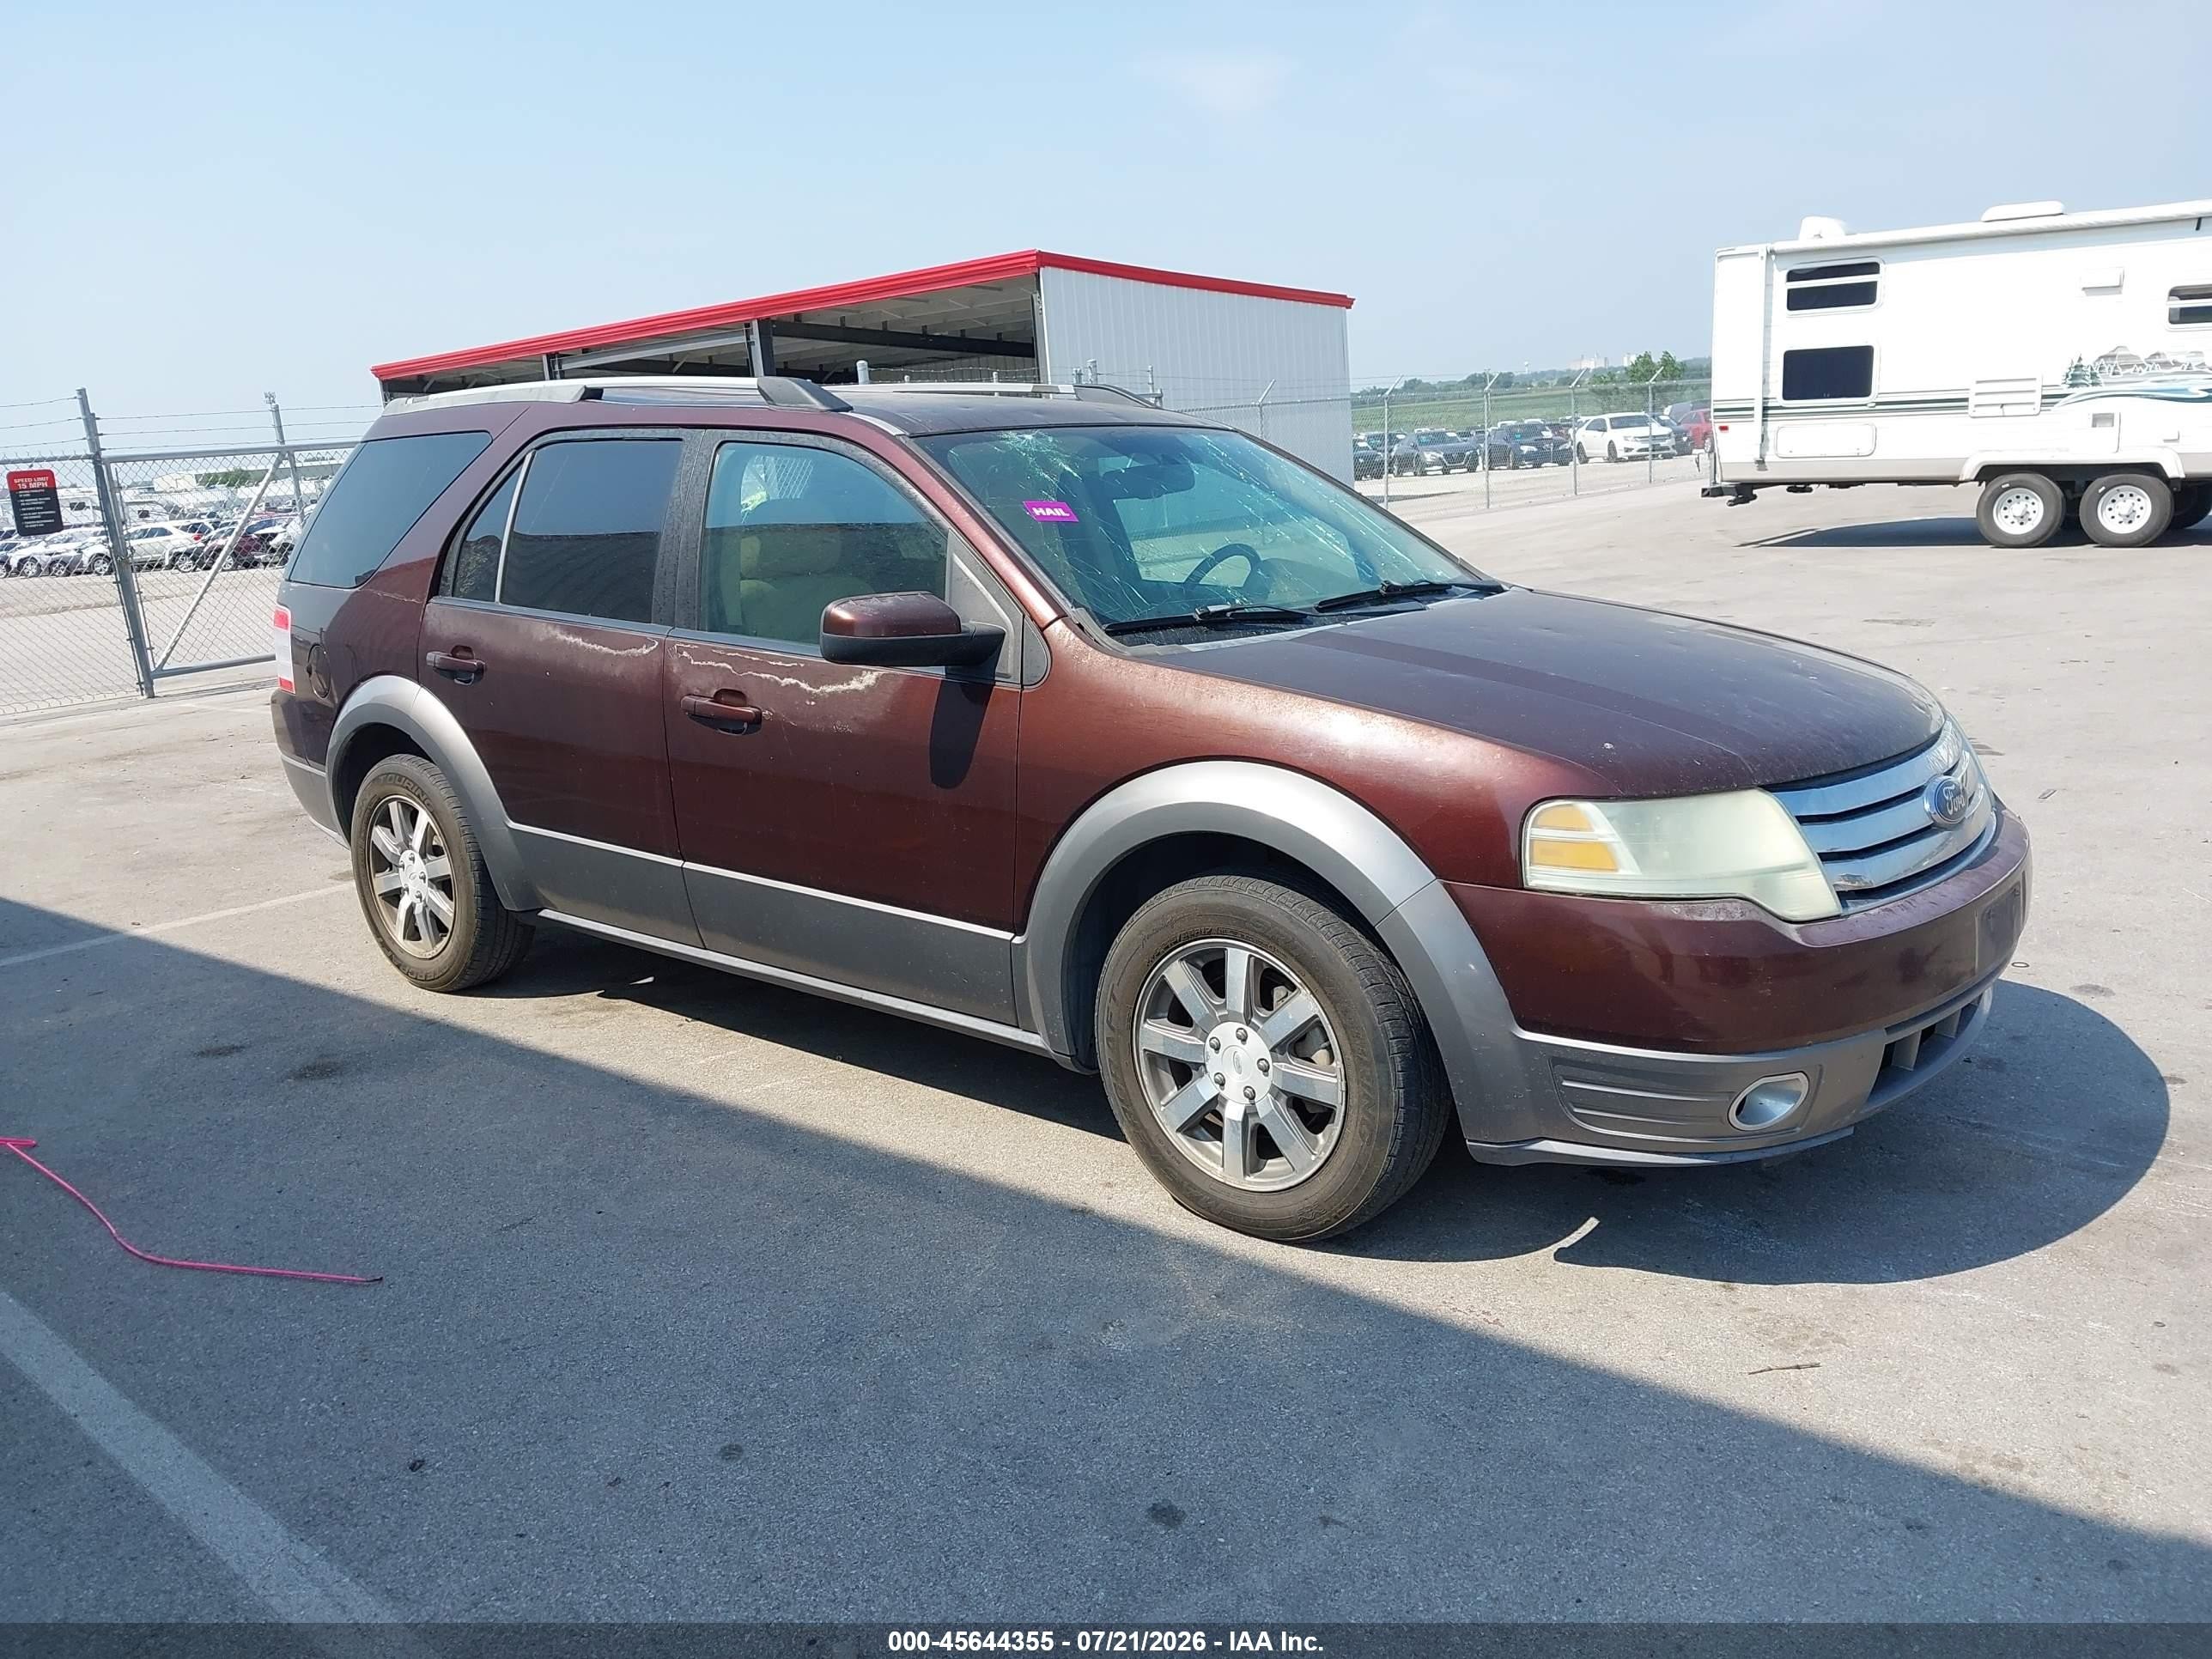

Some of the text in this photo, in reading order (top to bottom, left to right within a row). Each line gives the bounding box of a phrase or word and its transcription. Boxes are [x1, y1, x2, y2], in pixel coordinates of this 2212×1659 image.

[1032, 507, 1070, 516] HAIL
[379, 774, 434, 812] TOURING
[1943, 785, 1966, 815] Ford
